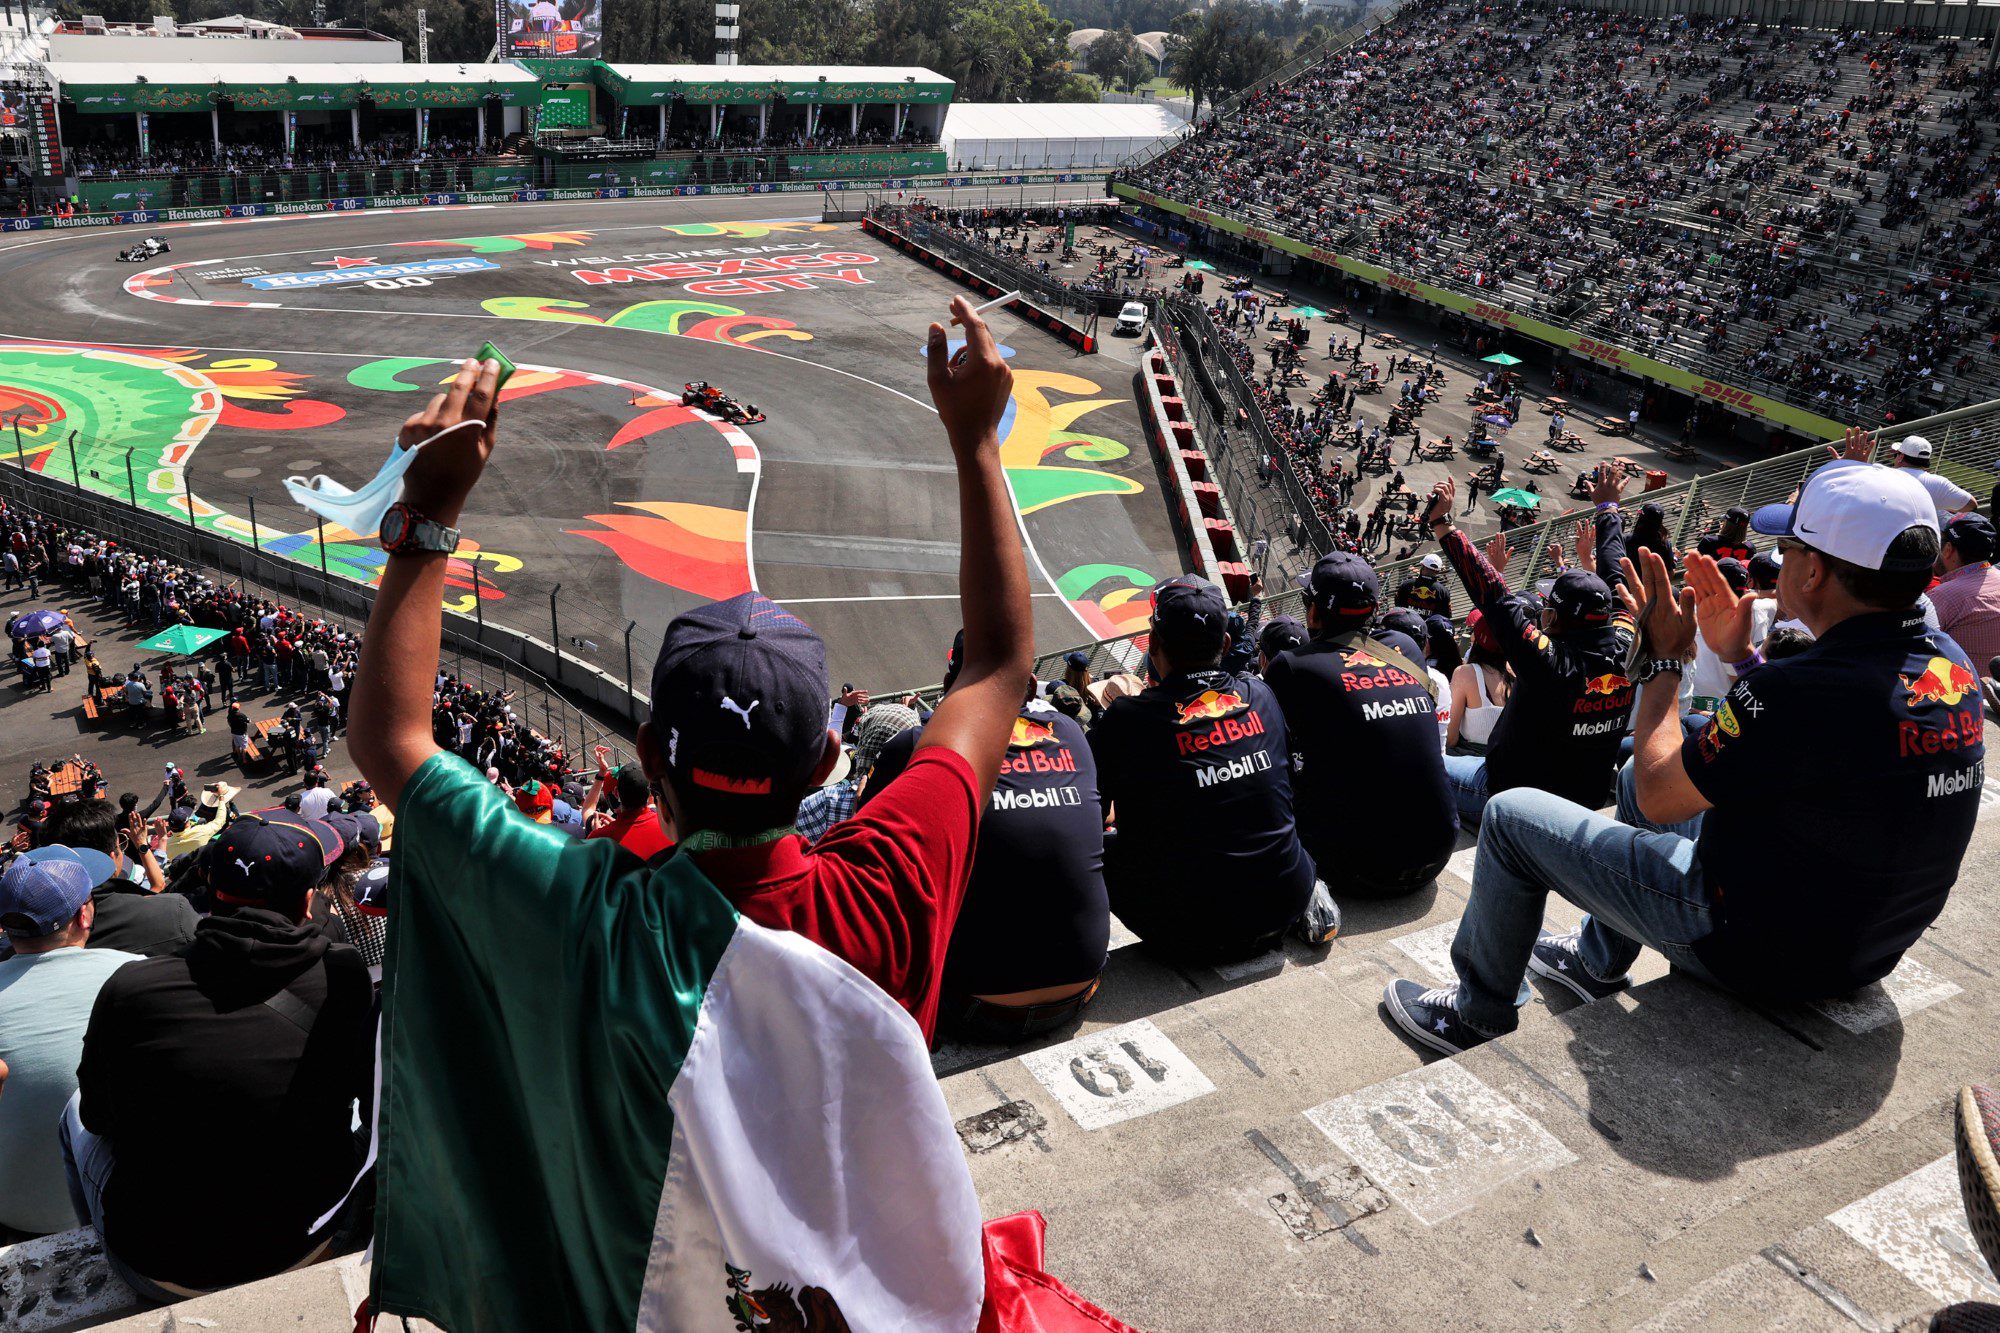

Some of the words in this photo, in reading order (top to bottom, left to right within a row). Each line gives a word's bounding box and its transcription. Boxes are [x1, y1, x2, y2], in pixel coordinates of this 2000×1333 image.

[466, 192, 509, 203] Heineken
[553, 189, 593, 200] Heineken
[633, 187, 671, 197] Heineken
[710, 184, 746, 194] Heineken
[782, 182, 815, 192] Heineken
[168, 207, 220, 220] Heineken
[275, 201, 323, 214] Heineken
[373, 196, 419, 208] Heineken
[53, 215, 110, 228] Heineken
[536, 247, 728, 267] WELCOME
[731, 241, 835, 254] BACK
[1310, 248, 1338, 266] DHL
[263, 259, 484, 287] Heineken
[570, 252, 880, 286] MEXICO
[683, 268, 875, 296] CITY
[1385, 273, 1418, 295] DHL
[1474, 302, 1514, 327] DHL
[1575, 337, 1622, 363] DHL
[1700, 379, 1756, 410] DHL
[1341, 669, 1389, 692] Red
[1387, 669, 1420, 686] Bu
[1362, 698, 1417, 721] Mobil
[1573, 698, 1607, 714] Red
[1604, 690, 1633, 710] Bull
[1733, 680, 1765, 719] itrix
[1175, 724, 1226, 756] Red
[1225, 710, 1265, 742] Bull
[1573, 719, 1612, 736] Mobil
[1899, 712, 1959, 758] Red
[1000, 750, 1031, 774] ed
[1031, 749, 1077, 773] Bull
[1196, 755, 1255, 788] Mobil
[1926, 766, 1974, 798] Mobil
[992, 787, 1061, 810] Mobil
